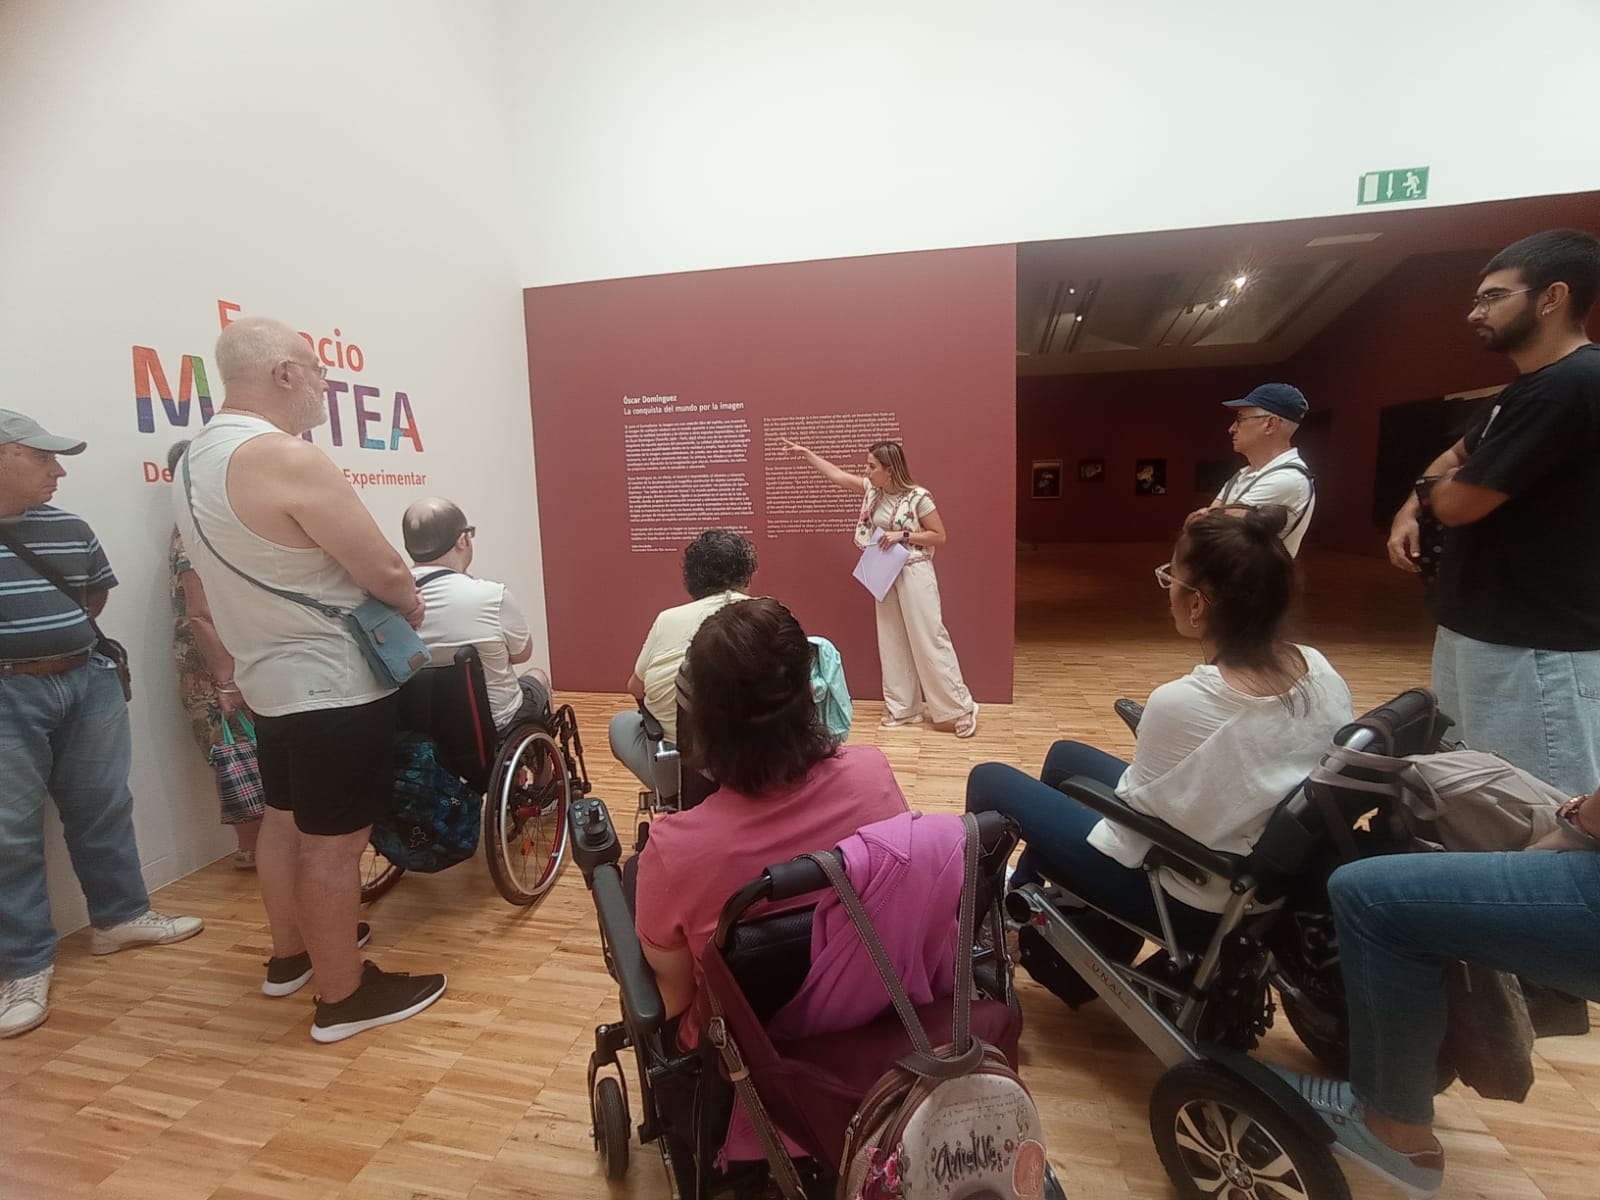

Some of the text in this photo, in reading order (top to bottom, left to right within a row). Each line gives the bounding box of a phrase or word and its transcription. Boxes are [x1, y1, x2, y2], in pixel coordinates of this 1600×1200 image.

[217, 299, 364, 372] Ecio
[132, 345, 424, 452] MTEA
[623, 394, 678, 405] Óscar Domínguez
[623, 402, 744, 416] La conquista del mundo por la imagen
[343, 468, 426, 489] Experimentar
